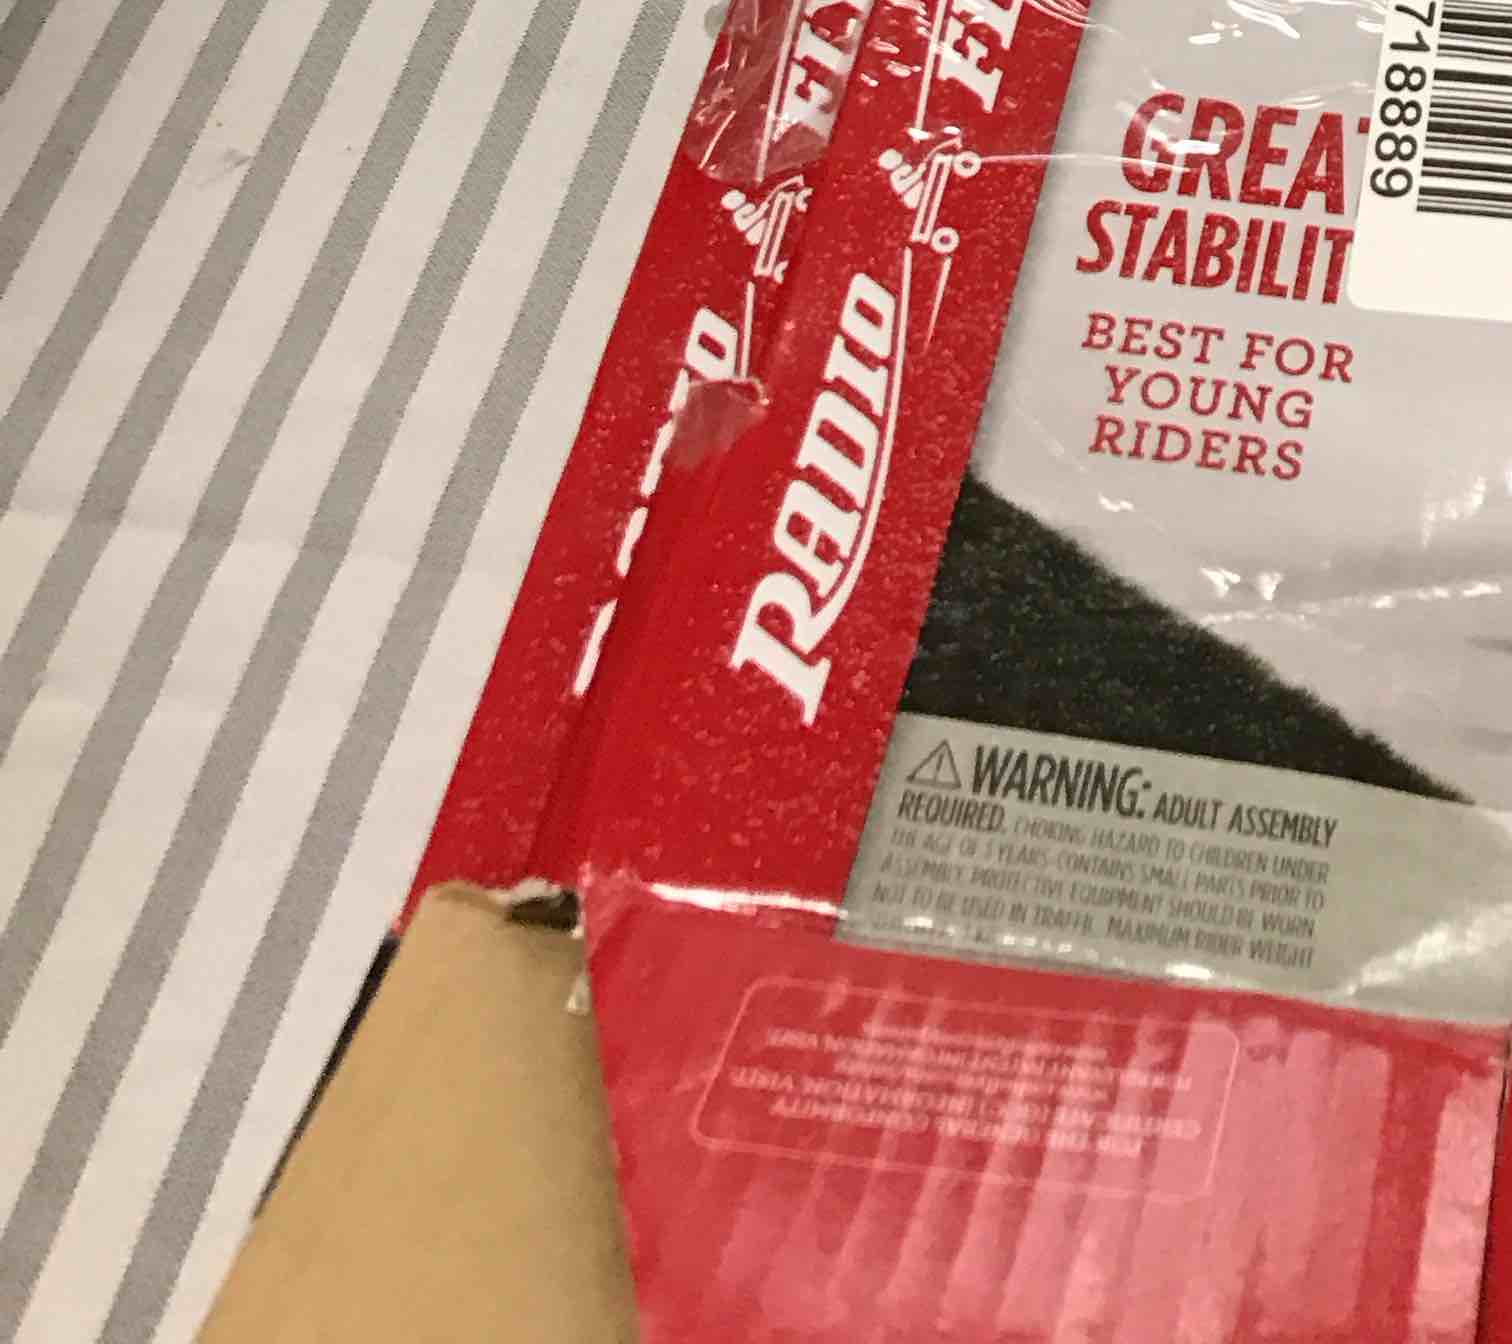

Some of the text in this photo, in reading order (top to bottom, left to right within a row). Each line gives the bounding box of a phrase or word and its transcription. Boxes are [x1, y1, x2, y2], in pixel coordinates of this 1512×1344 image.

[1120, 92, 1371, 215] GREA
[1081, 311, 1355, 383] BEST FOR
[1104, 364, 1315, 430] YOUNG
[1088, 414, 1305, 481] RIDERS
[728, 272, 905, 728] RADIO
[897, 789, 1007, 834] REQUIRED.
[970, 742, 1339, 850] WARNING: ADULT ASSEMBLY
